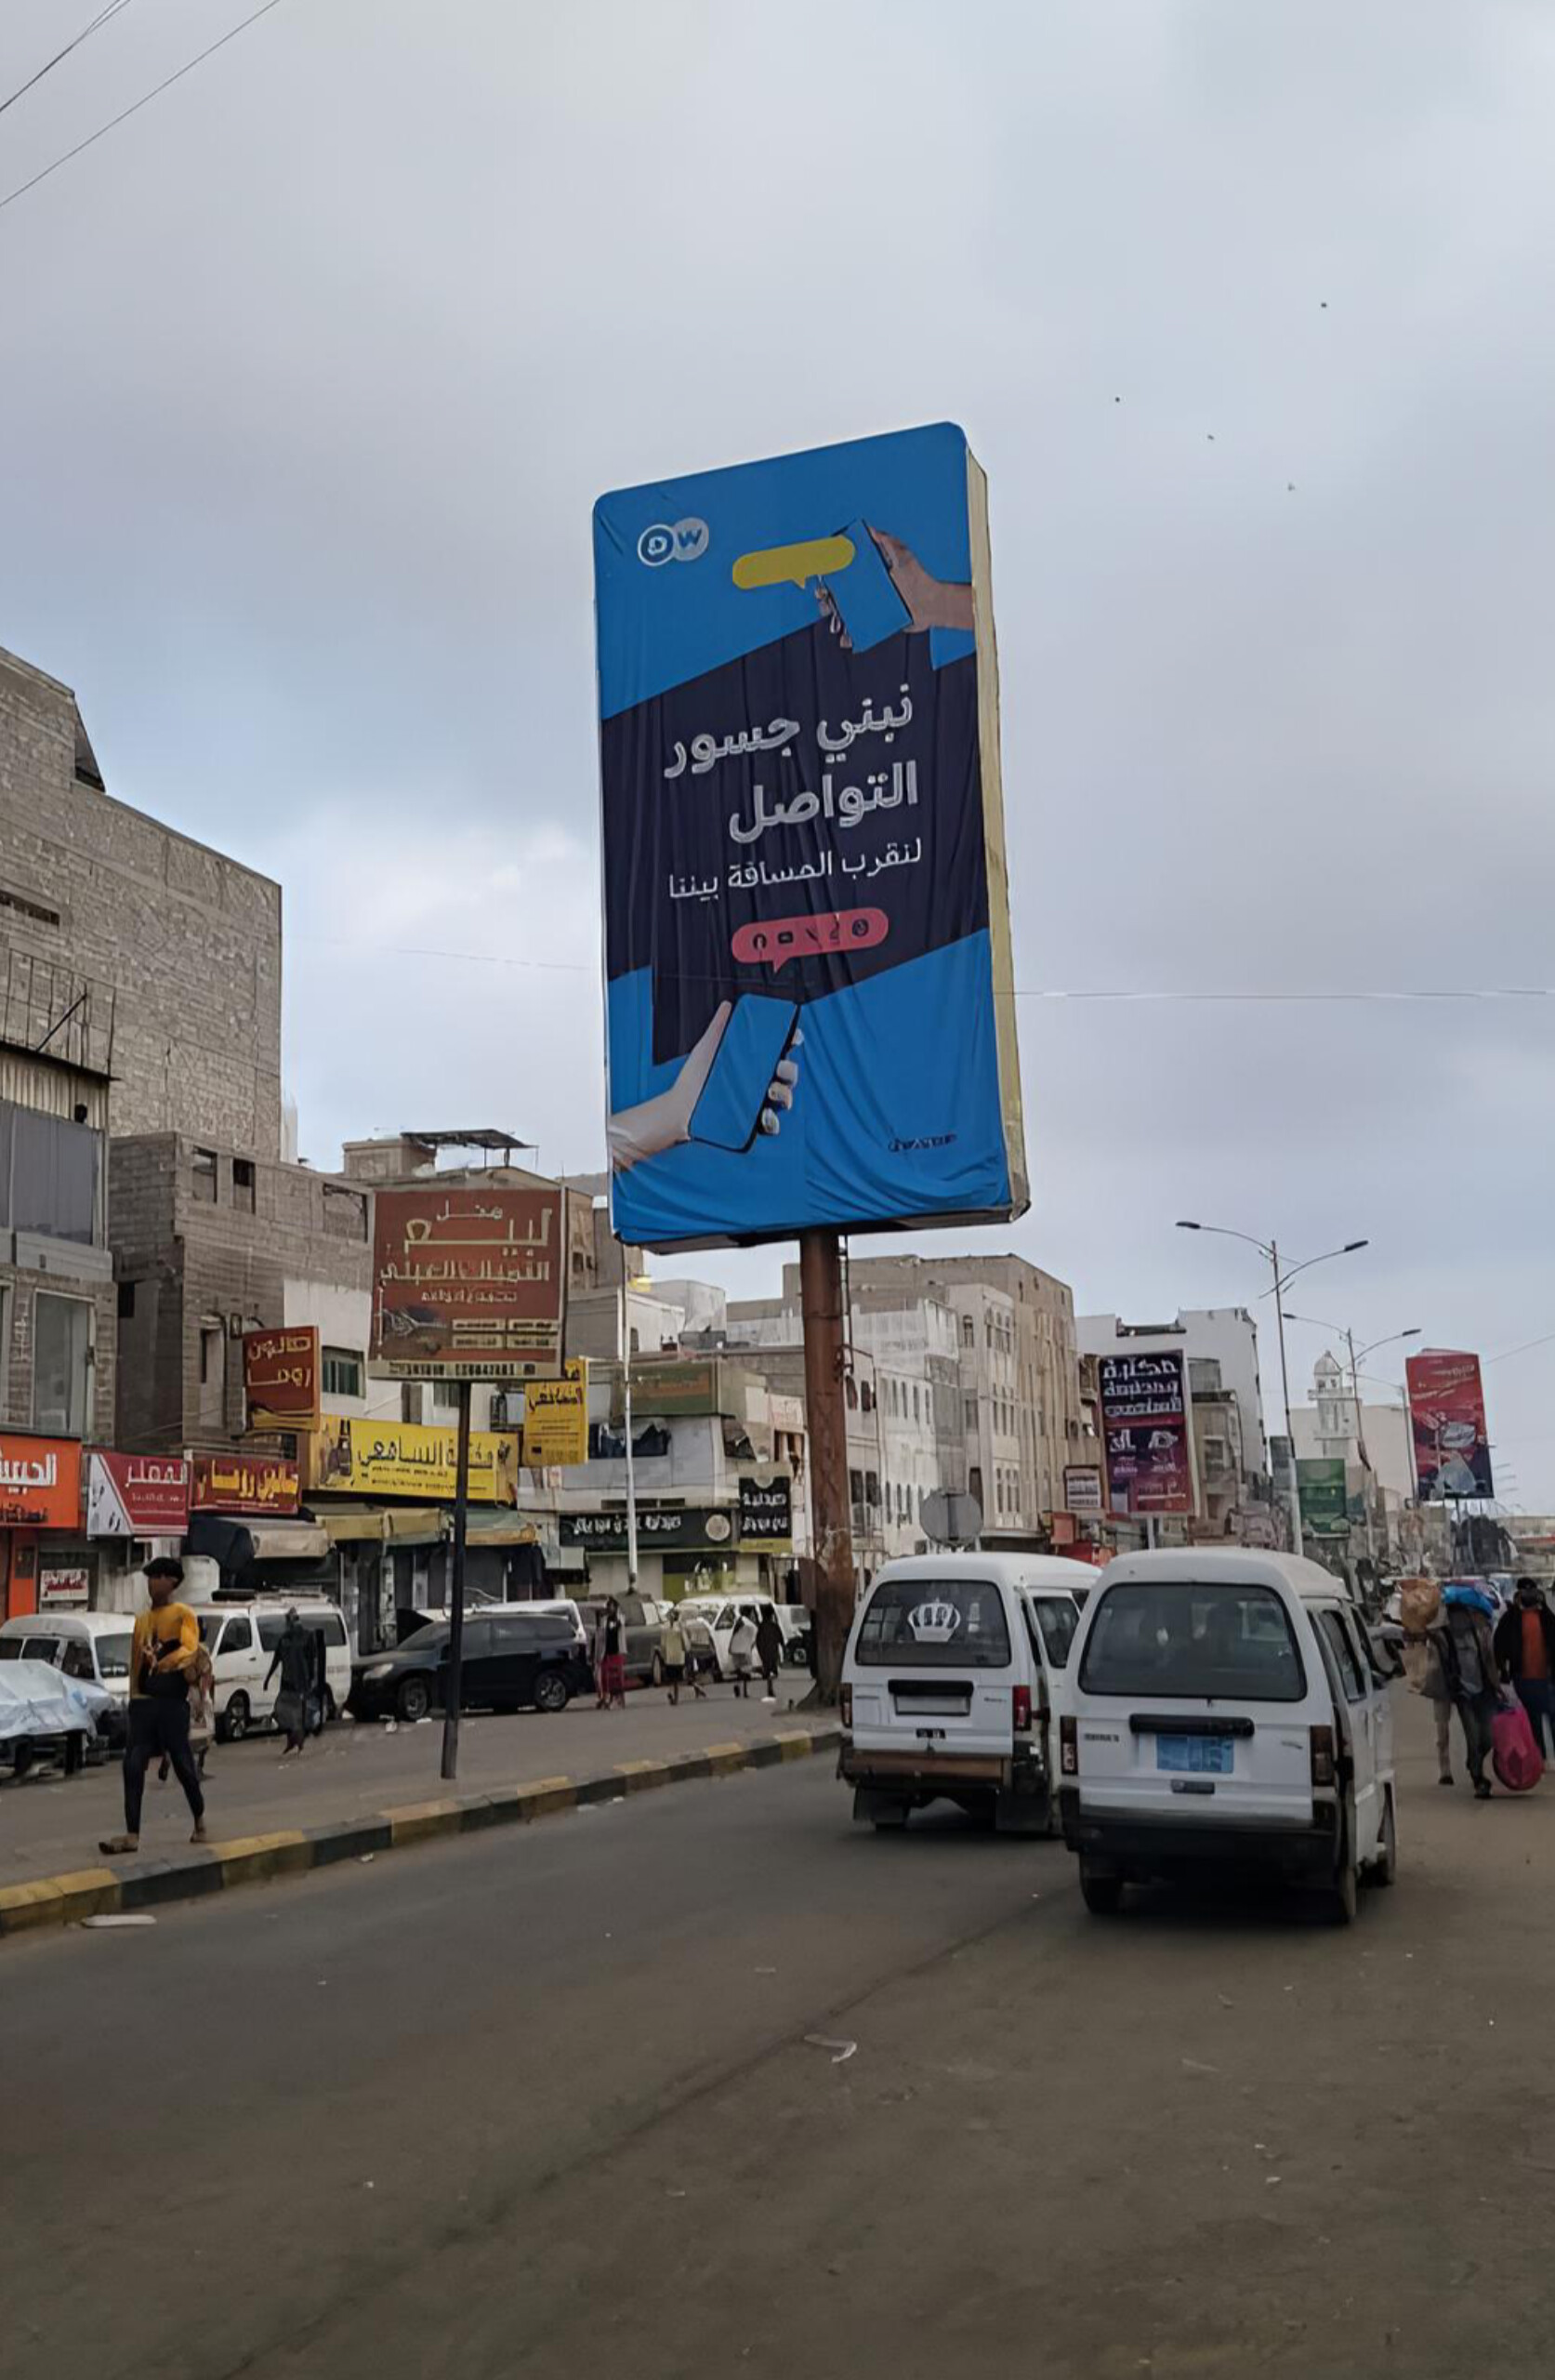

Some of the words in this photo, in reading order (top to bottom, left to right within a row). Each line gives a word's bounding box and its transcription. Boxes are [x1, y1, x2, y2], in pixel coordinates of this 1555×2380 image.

[639, 518, 709, 565] DW
[818, 683, 913, 762] نبني
[664, 718, 800, 778] جسور
[730, 760, 918, 842] التواصل
[728, 851, 832, 888] المسافة
[841, 838, 921, 879] لنقرب
[669, 875, 718, 902] بيننا
